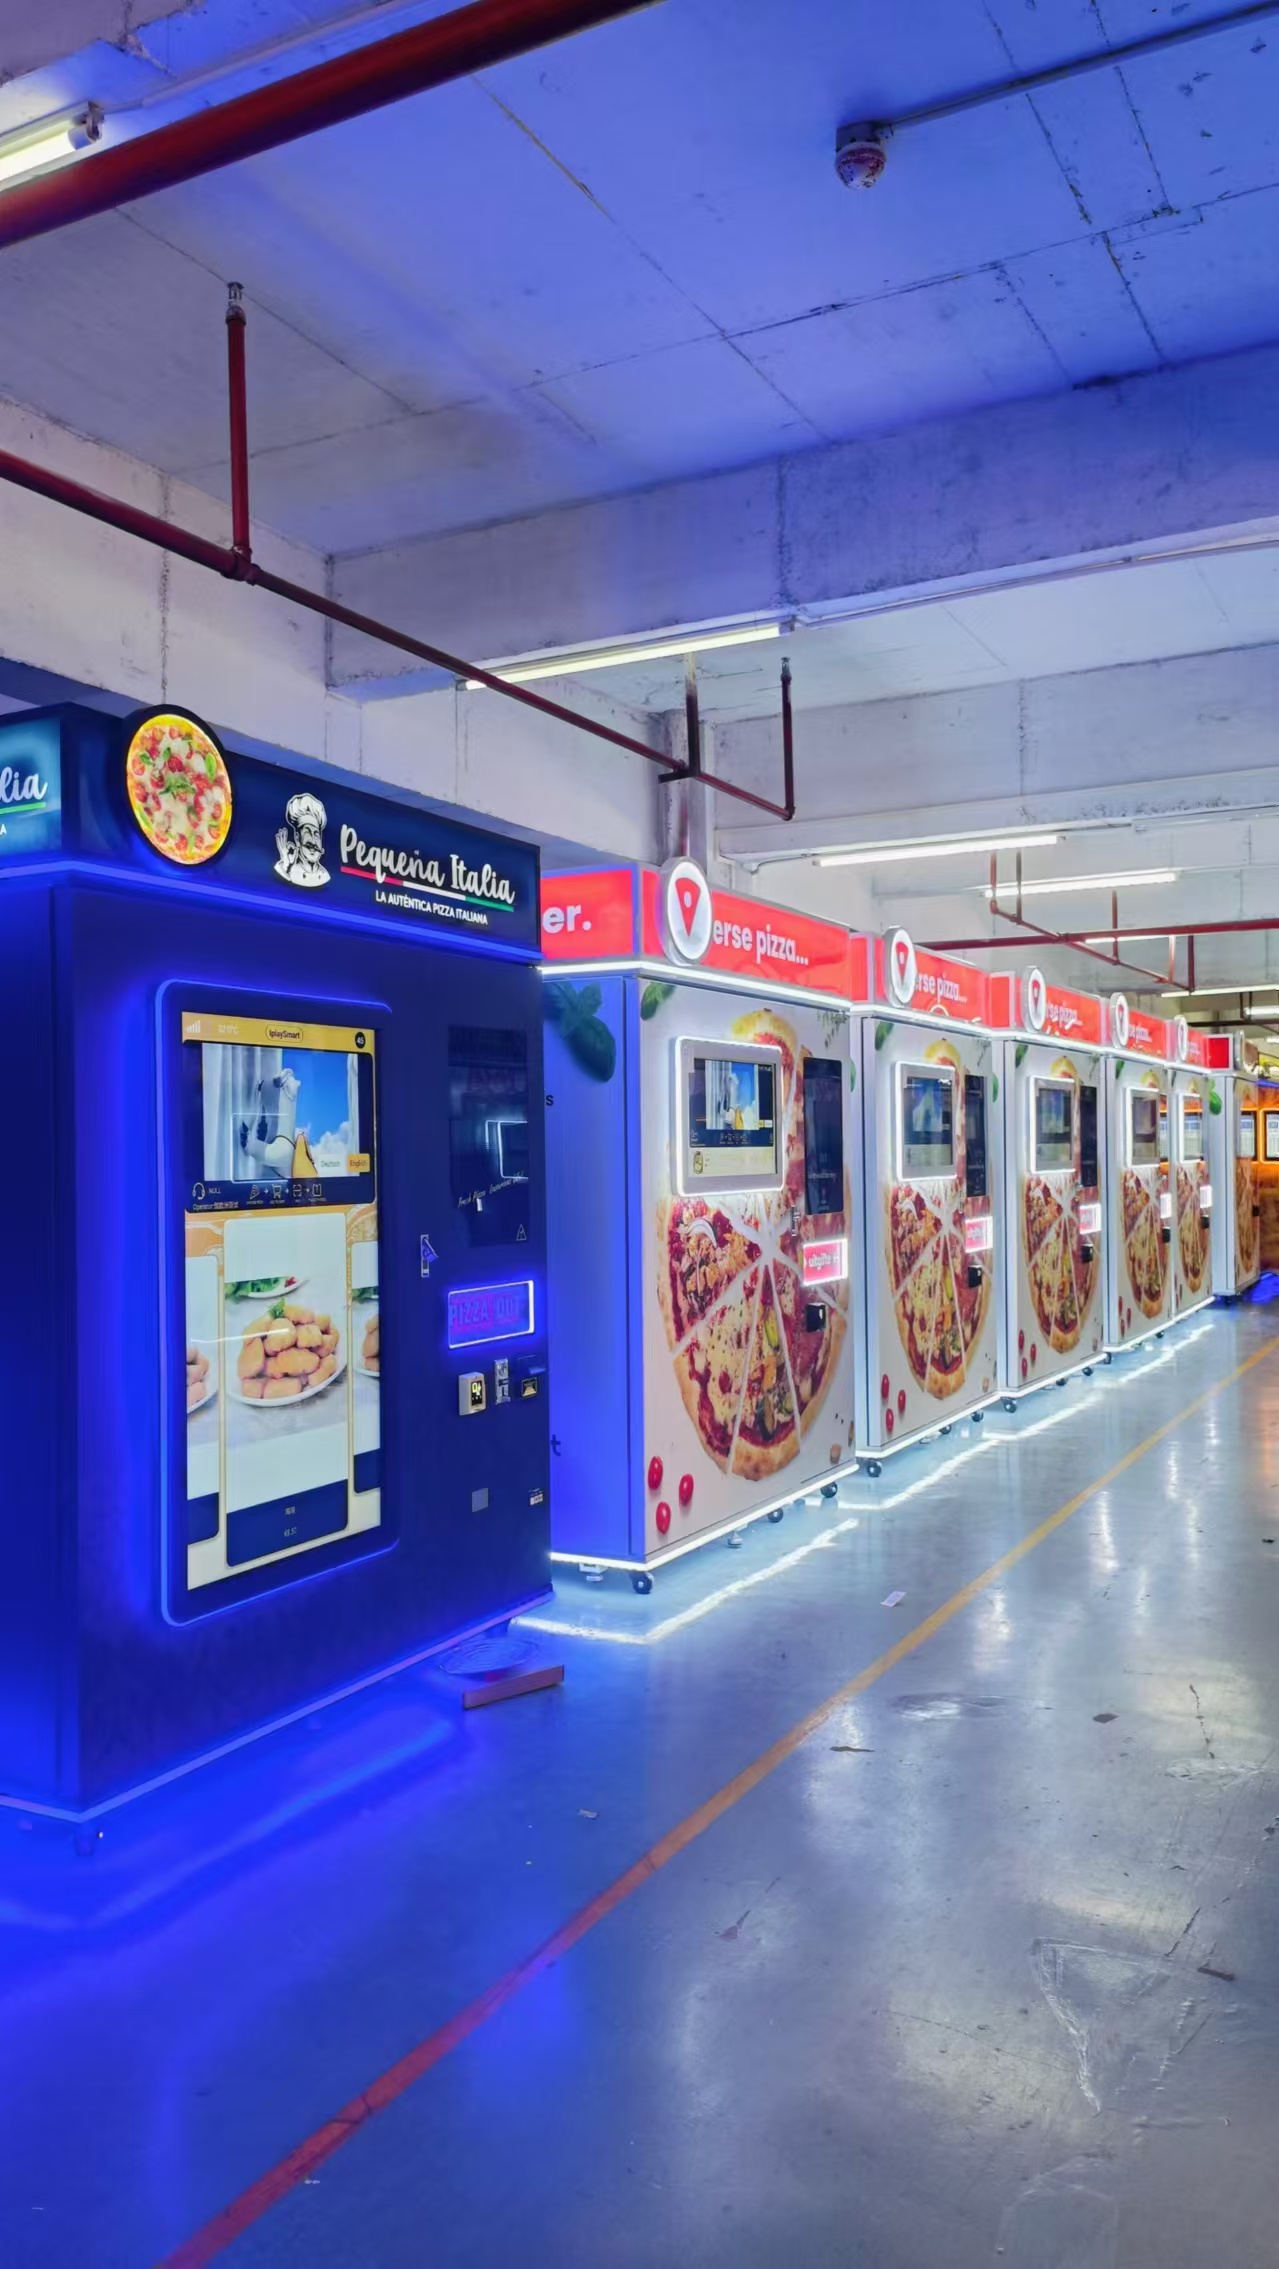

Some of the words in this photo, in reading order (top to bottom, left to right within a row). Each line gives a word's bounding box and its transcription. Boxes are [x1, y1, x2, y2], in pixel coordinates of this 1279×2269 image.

[340, 824, 445, 884] Pequeña
[449, 854, 515, 904] Italia
[375, 890, 386, 903] LA
[388, 892, 432, 913] AUTÉNTICA
[433, 903, 455, 918] PIZZA
[456, 908, 488, 925] ITALIANA
[543, 904, 592, 934] er.
[713, 920, 753, 951] erse
[756, 923, 809, 965] pizza...
[450, 1299, 489, 1328] PIZZA
